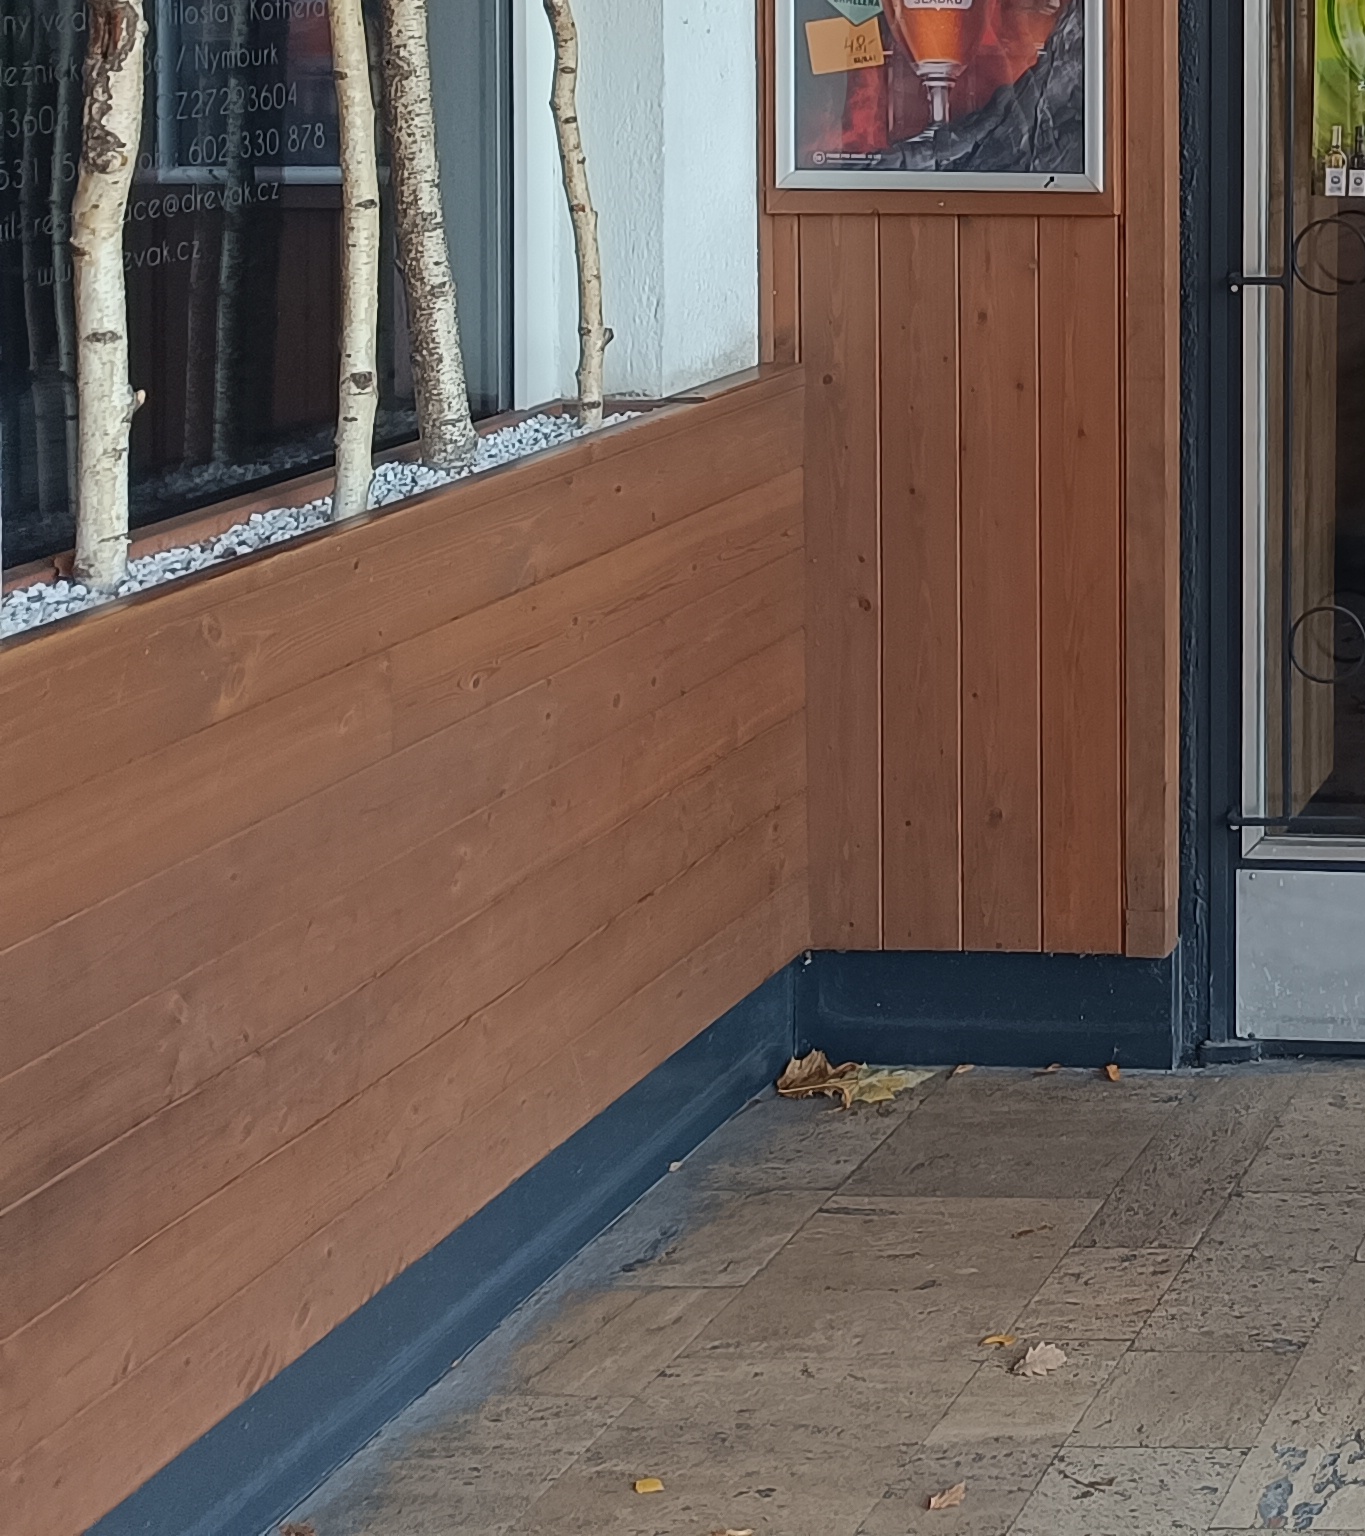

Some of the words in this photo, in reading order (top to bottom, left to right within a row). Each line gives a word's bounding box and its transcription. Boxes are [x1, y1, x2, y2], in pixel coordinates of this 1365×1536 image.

[194, 41, 279, 75] Nymburk
[241, 127, 281, 159] 330
[287, 122, 326, 153] 878
